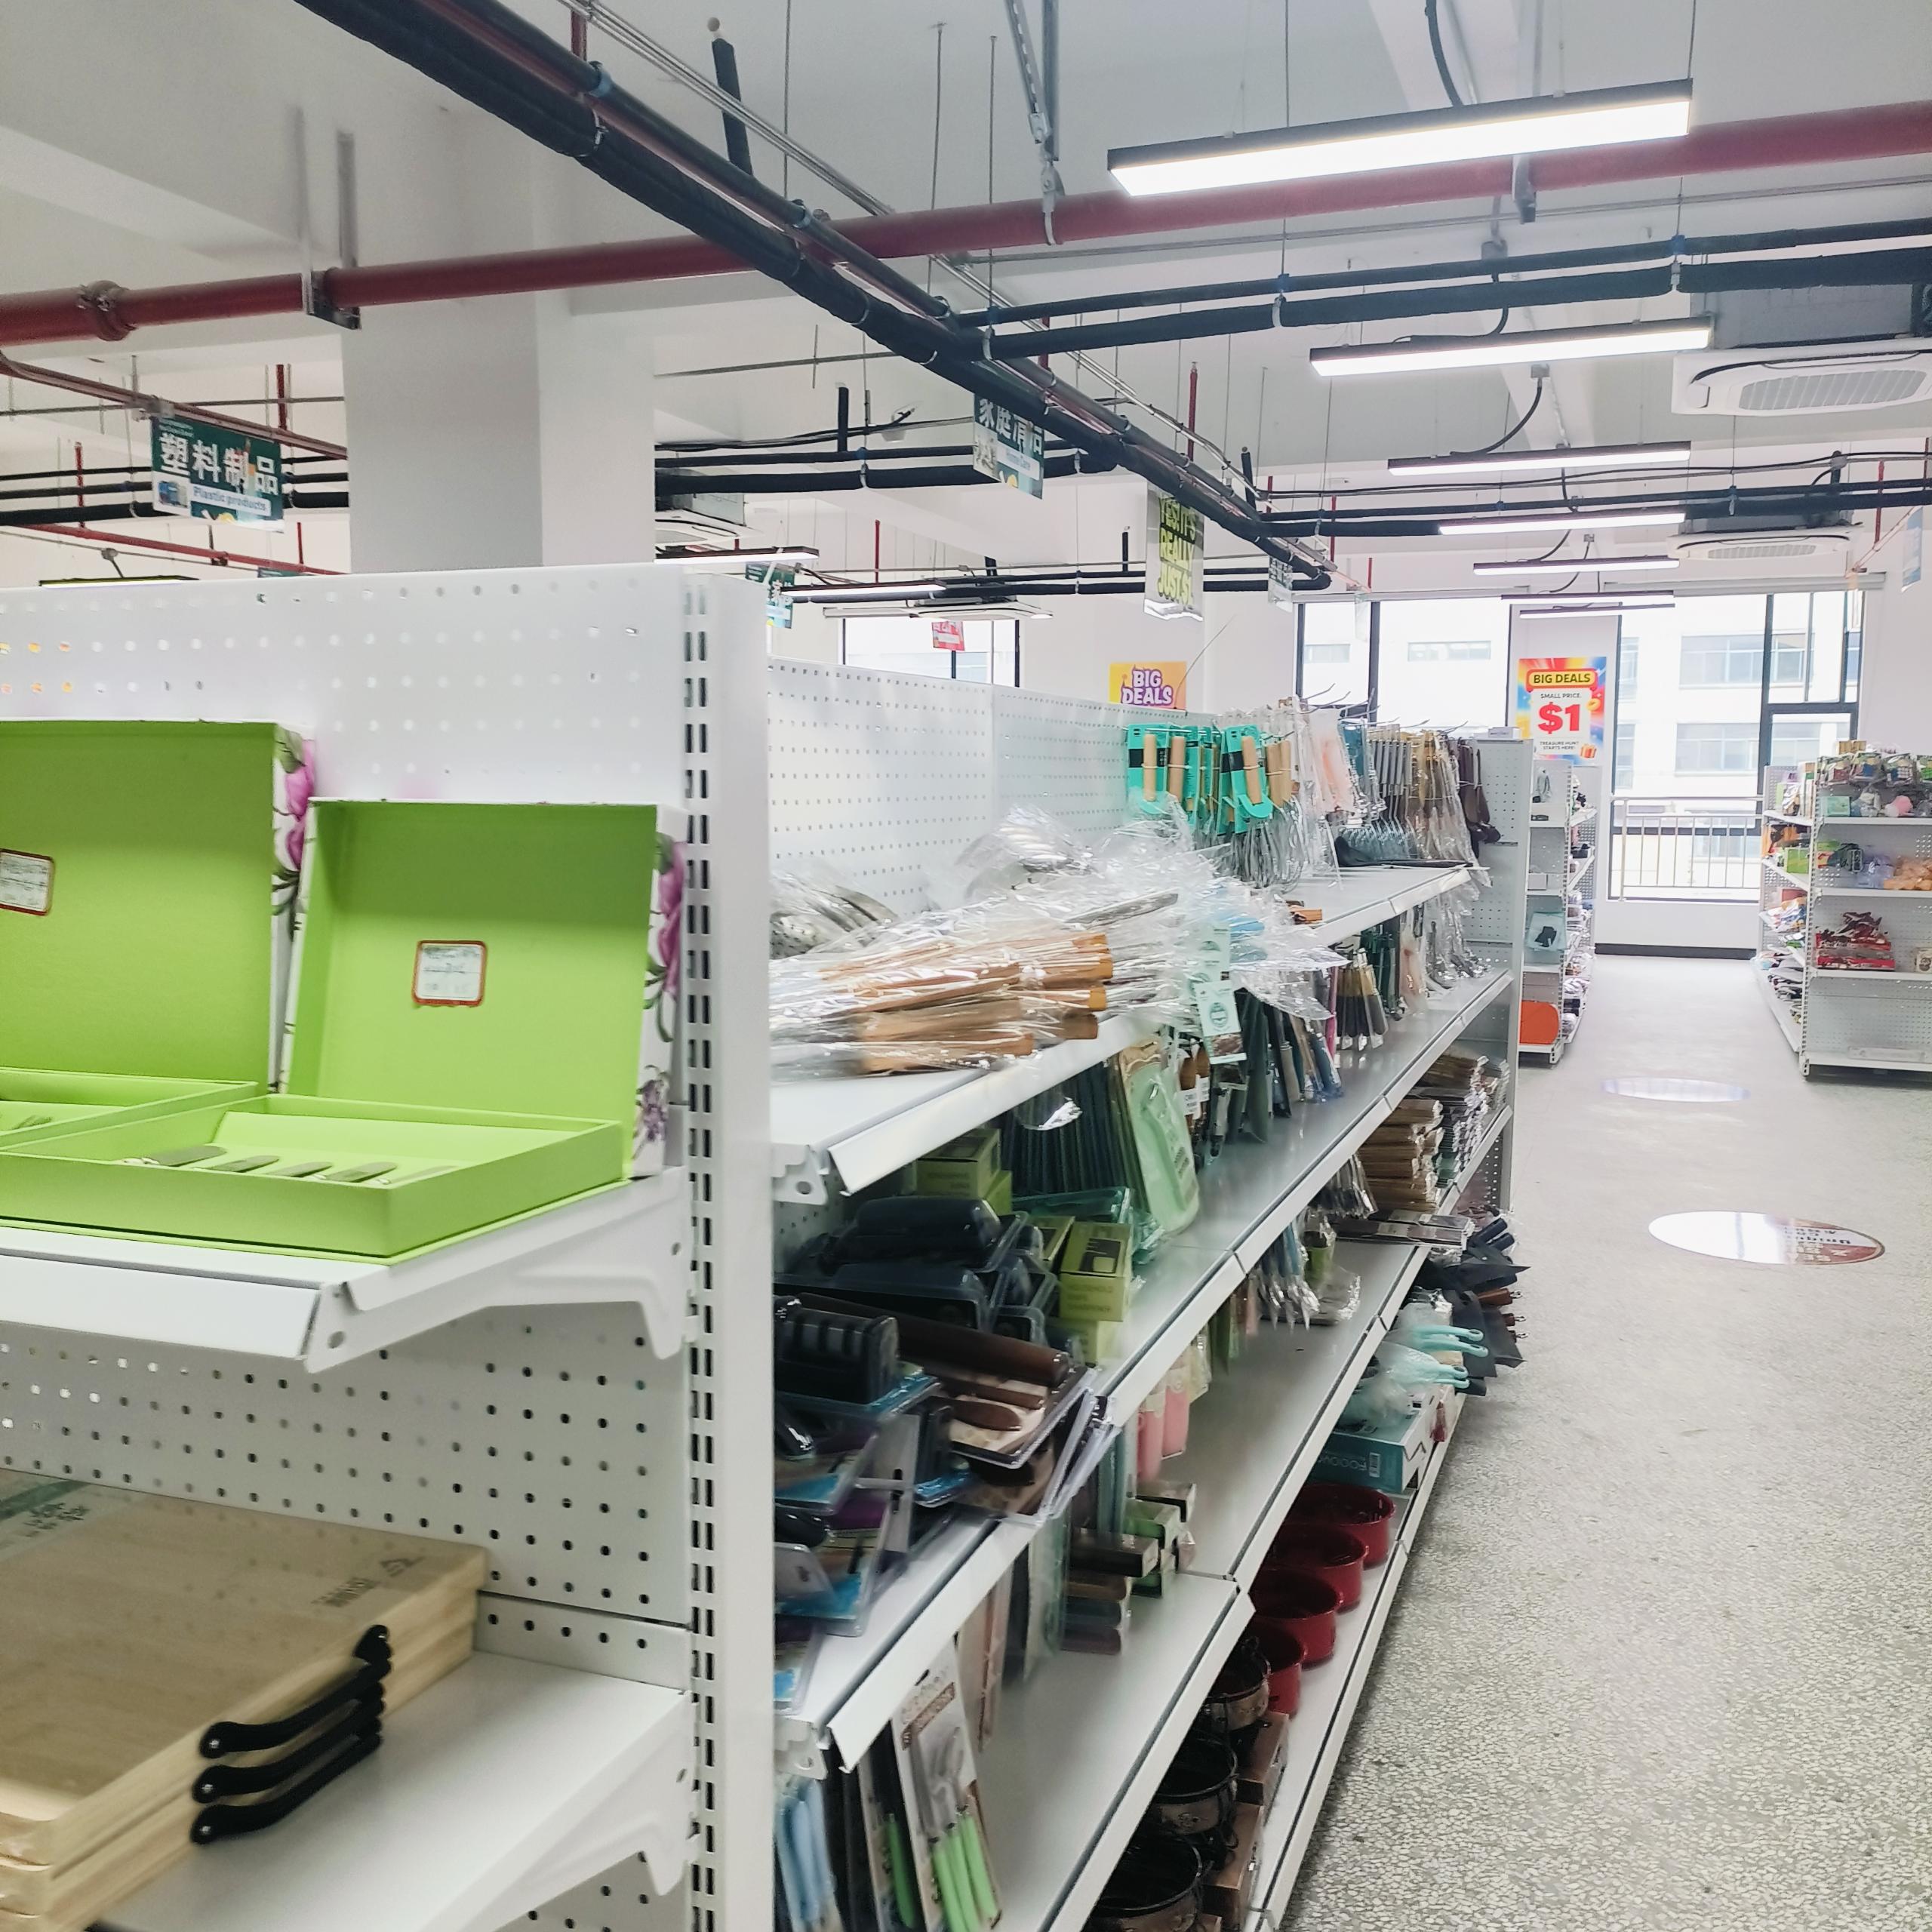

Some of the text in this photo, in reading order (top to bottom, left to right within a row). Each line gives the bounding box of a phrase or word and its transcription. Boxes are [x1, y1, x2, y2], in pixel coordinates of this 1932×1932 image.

[159, 432, 278, 495] 塑料制品
[1132, 668, 1163, 688] BIG
[1534, 673, 1591, 684] BIG DEALS
[1121, 685, 1174, 706] DEALS
[1537, 701, 1580, 734] $1
